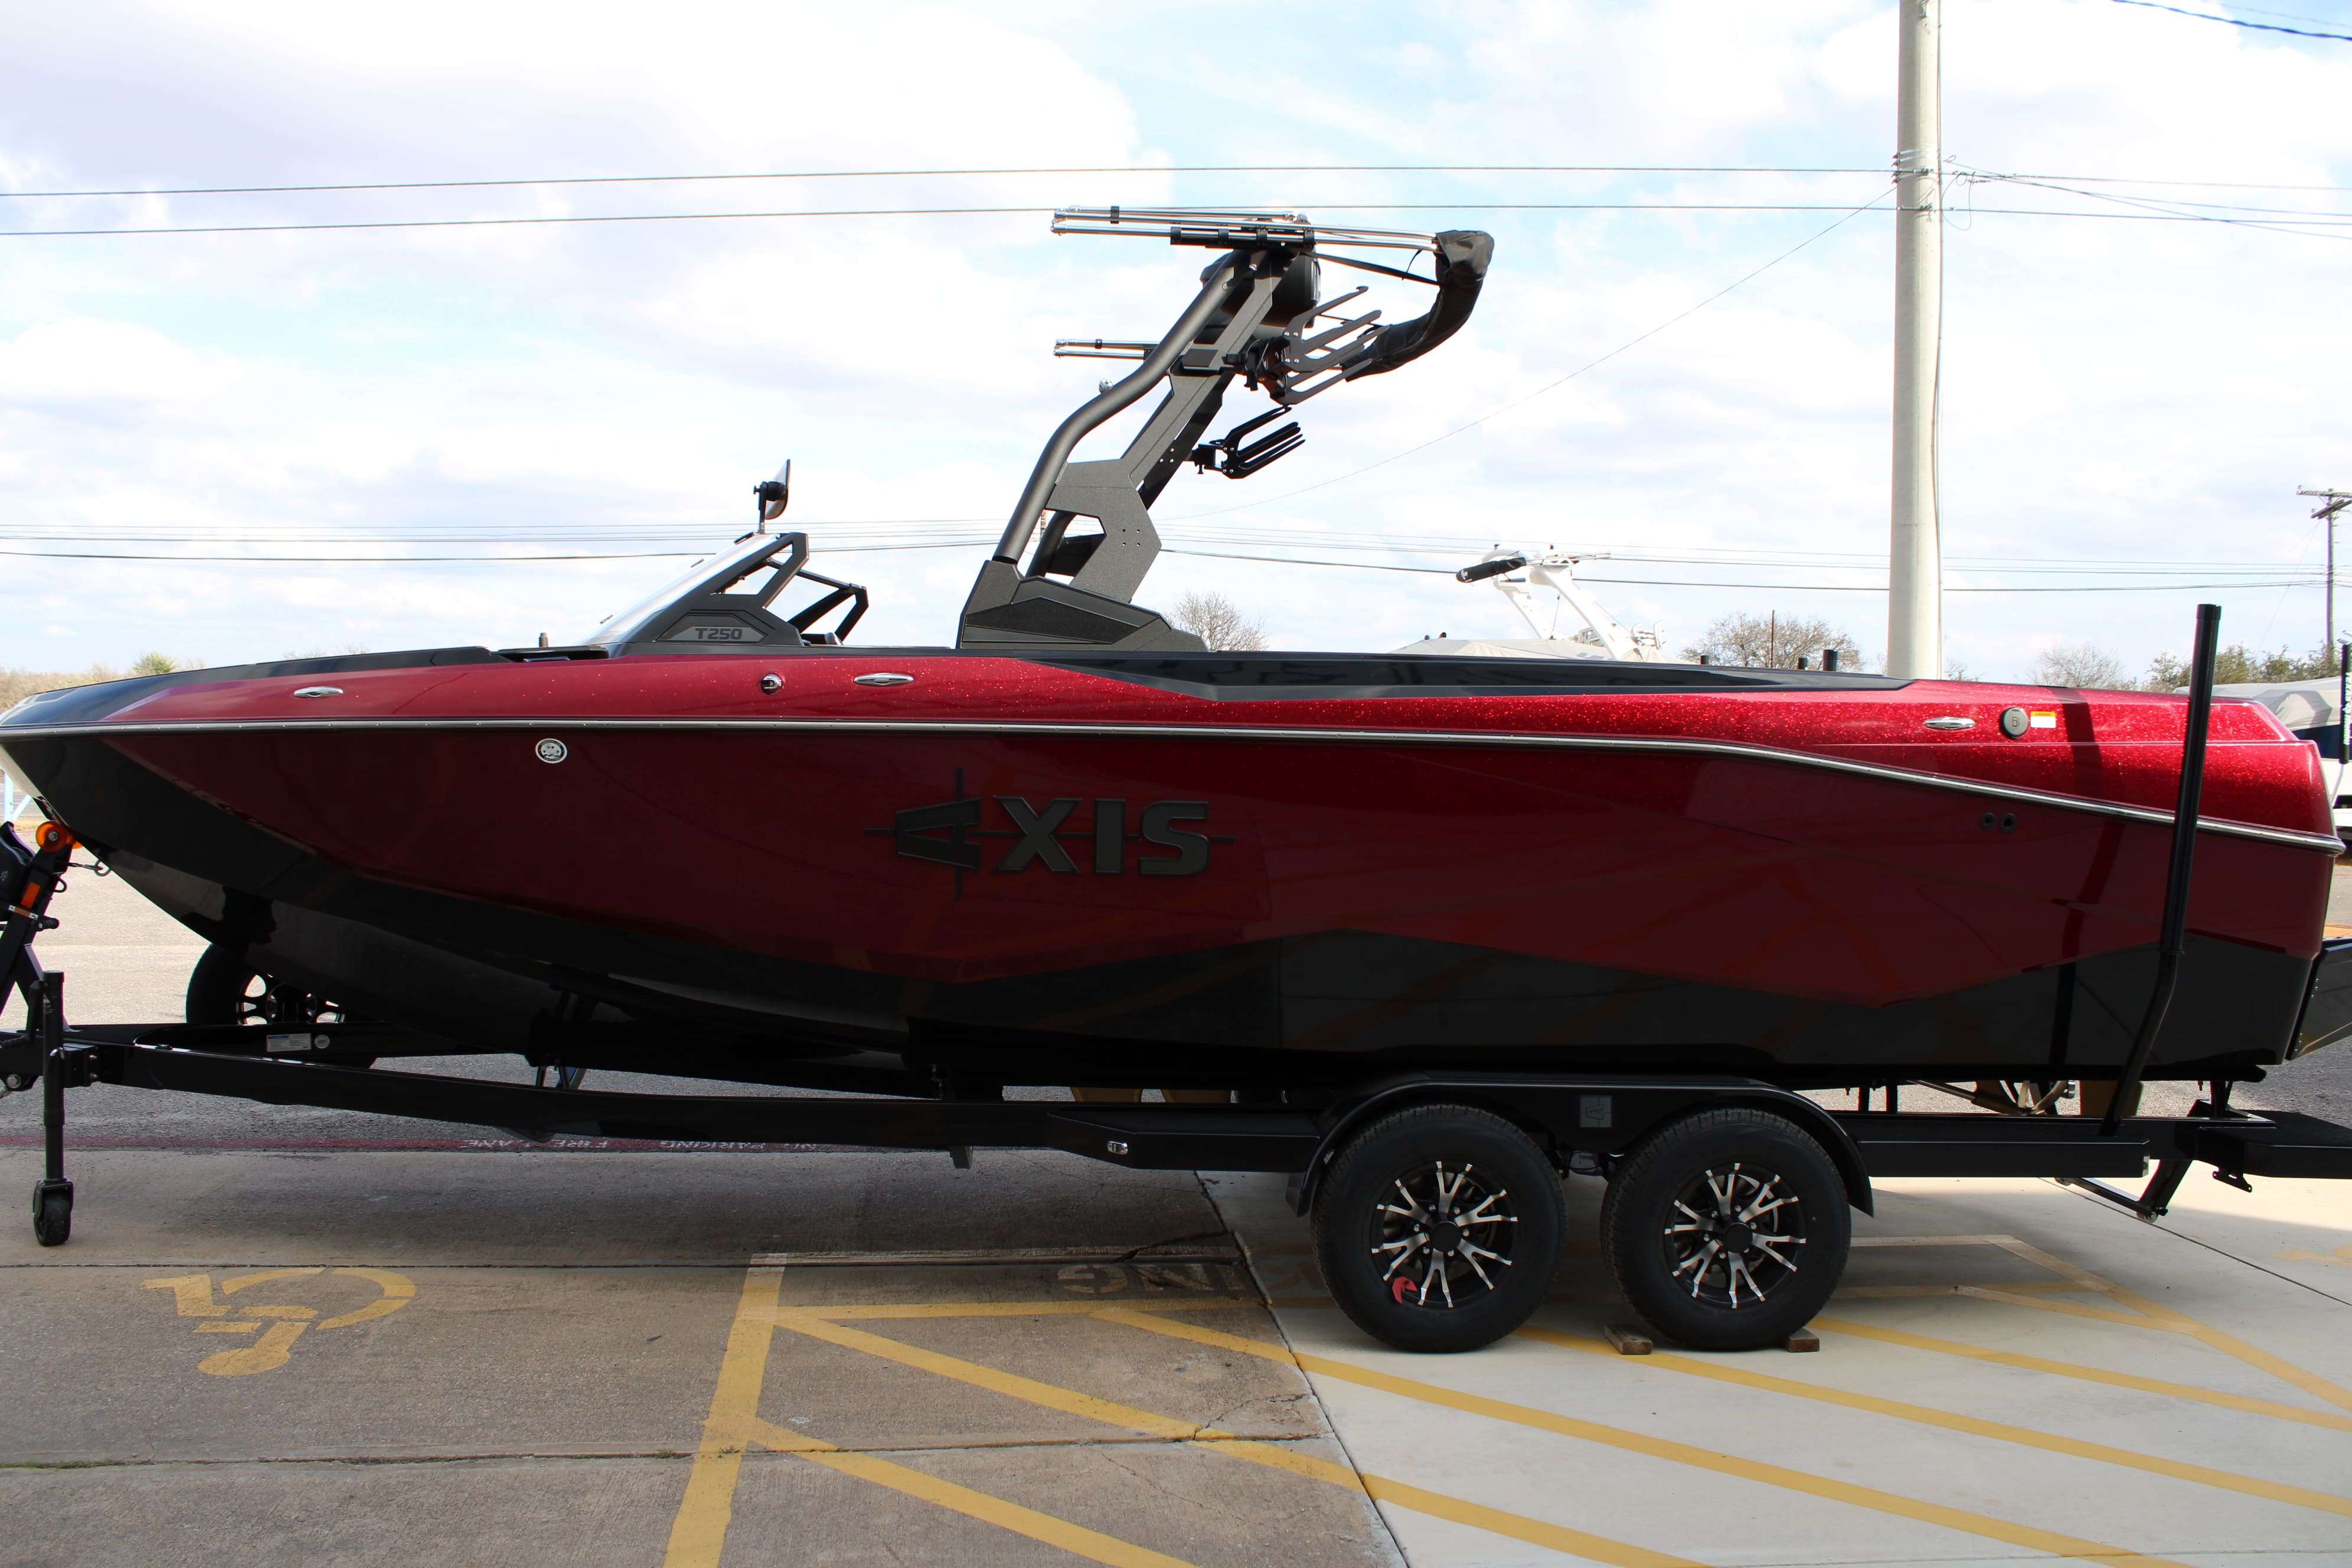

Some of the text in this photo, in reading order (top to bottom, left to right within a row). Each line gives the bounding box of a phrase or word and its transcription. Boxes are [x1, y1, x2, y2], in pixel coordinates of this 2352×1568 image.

[695, 628, 743, 640] T250
[895, 795, 1211, 877] AXIS
[459, 1139, 531, 1148] LANE
[550, 1139, 609, 1148] FIRE
[659, 1139, 766, 1149] PARKING
